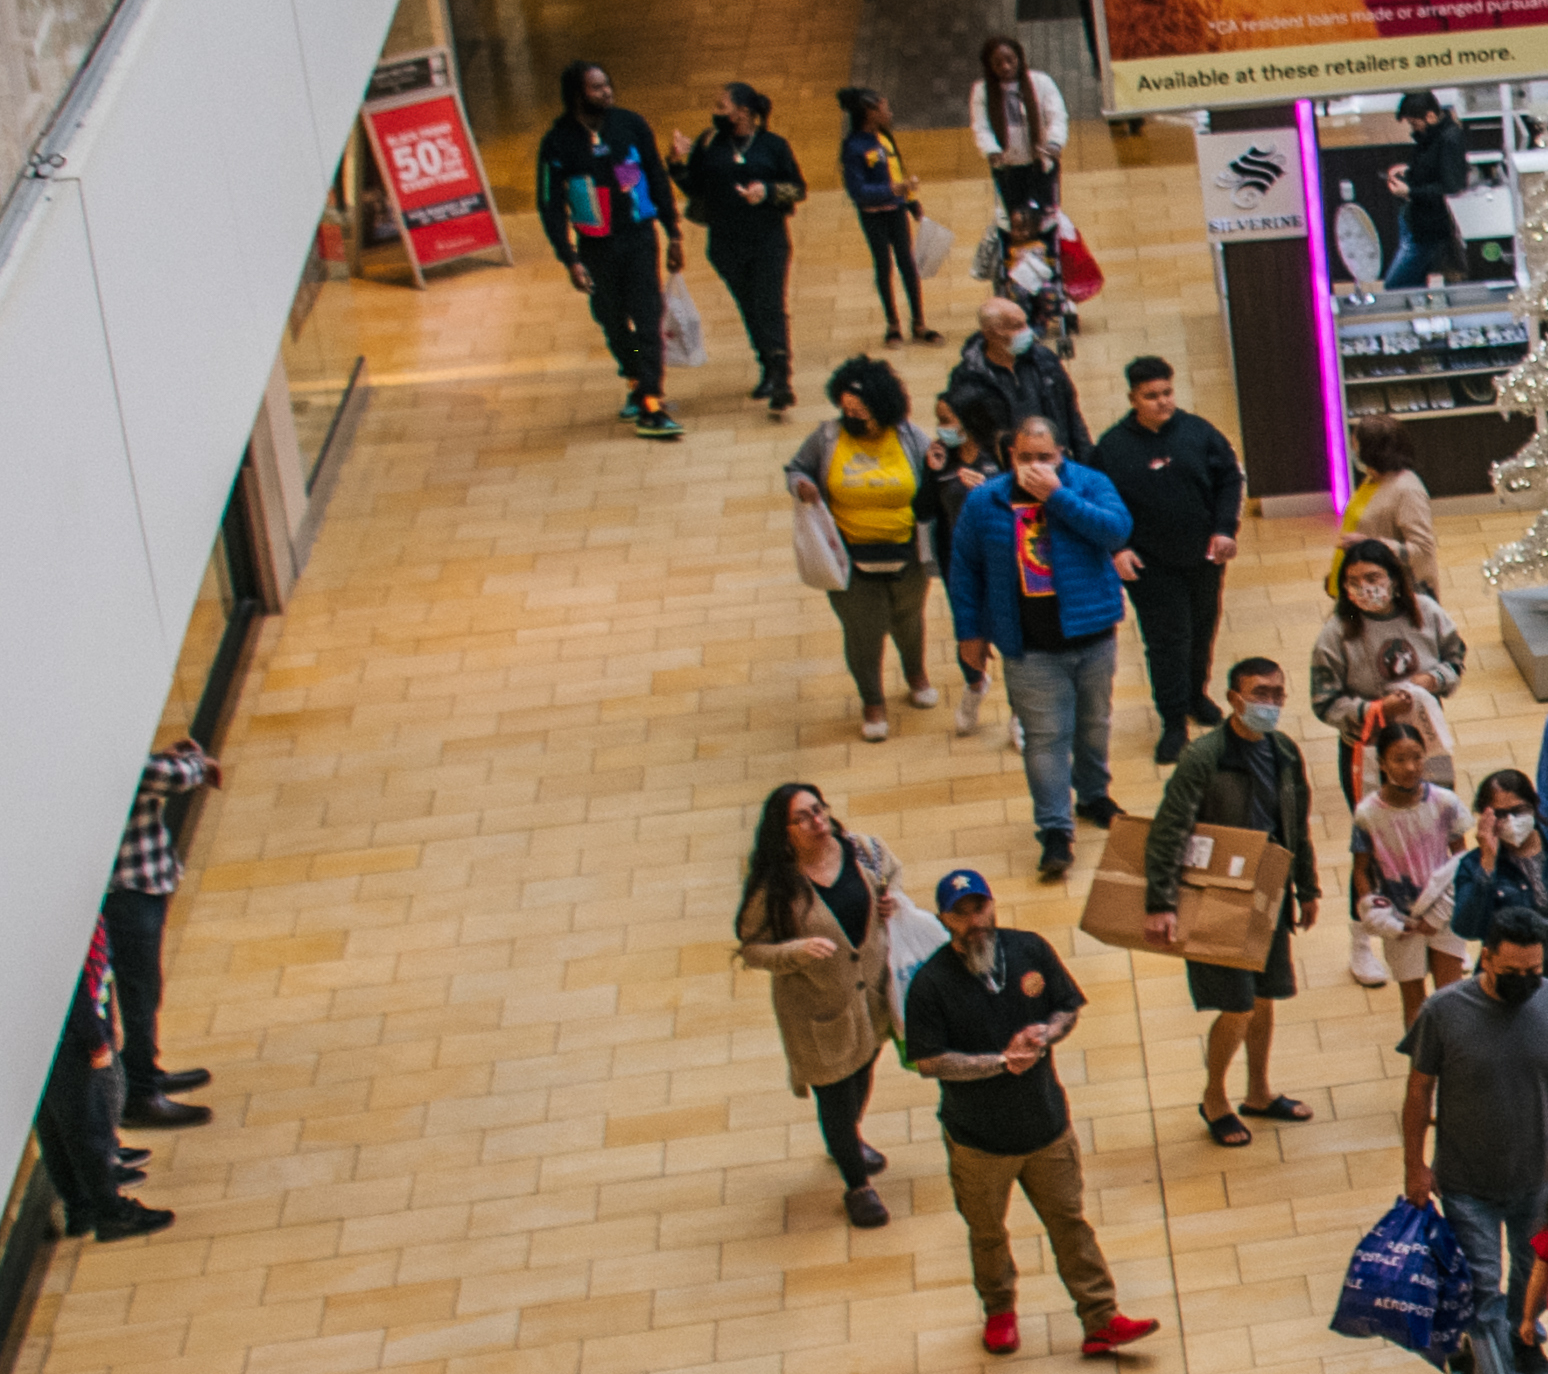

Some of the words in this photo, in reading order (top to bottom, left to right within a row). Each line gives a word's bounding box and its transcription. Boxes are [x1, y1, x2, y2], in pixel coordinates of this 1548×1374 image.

[1352, 8, 1394, 24] made
[1397, 7, 1413, 20] or
[1416, 0, 1485, 20] arranged
[1136, 68, 1230, 93] Available
[1235, 67, 1256, 85] at
[1261, 59, 1321, 83] these
[1324, 51, 1411, 77] retailers
[1414, 49, 1453, 70] and
[1457, 45, 1517, 66] more.
[1208, 215, 1304, 233] SILVERINE
